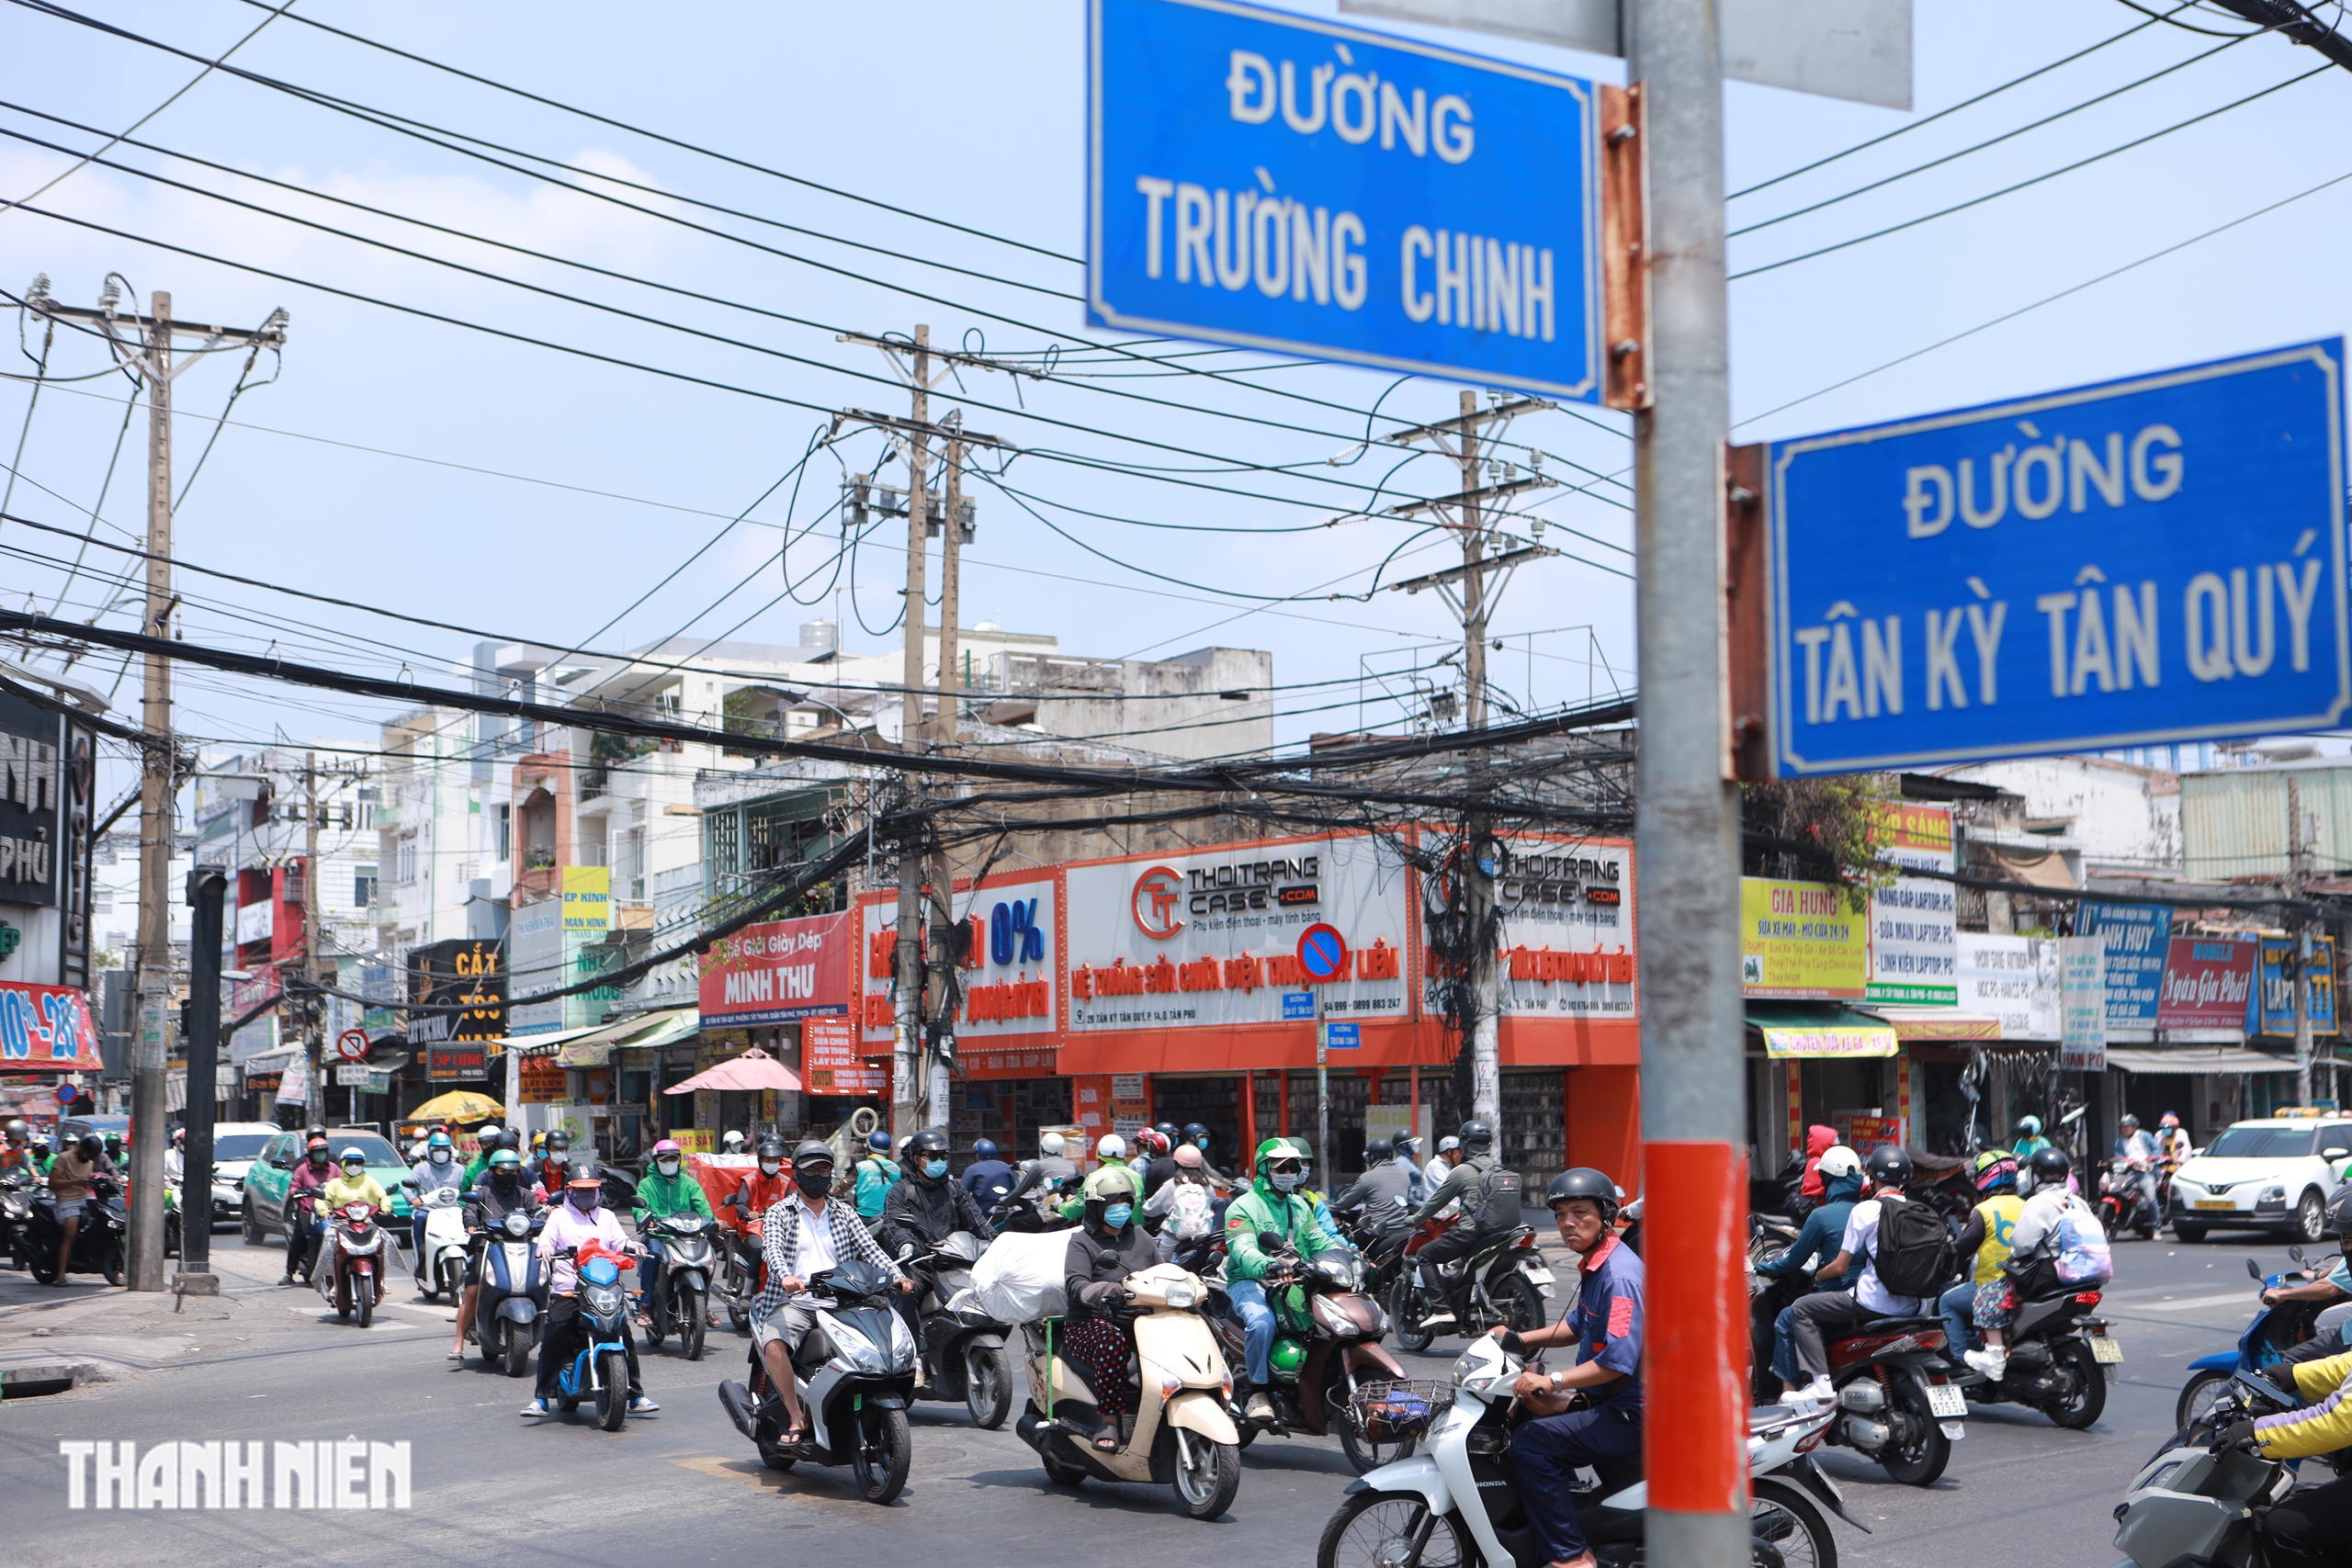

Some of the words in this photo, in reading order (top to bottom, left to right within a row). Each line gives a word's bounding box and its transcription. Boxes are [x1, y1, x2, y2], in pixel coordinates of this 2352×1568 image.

[1227, 42, 1476, 164] ĐƯỜNG
[1136, 166, 1368, 311] TRƯỜNG
[1401, 224, 1555, 343] CHINH
[1902, 420, 2185, 539] ĐƯỜNG
[1795, 600, 1904, 725] TÂN
[1927, 576, 2007, 710] KỲ
[2036, 564, 2160, 698] TÂN
[2185, 529, 2323, 683] QUÝ
[1906, 811, 1950, 847] SÁNG
[1187, 856, 1319, 889] THOITRANG
[563, 890, 578, 903] ÉP
[581, 891, 607, 903] KÍNH
[1189, 888, 1270, 915] CASE
[1501, 882, 1577, 904] CASE
[1772, 887, 1795, 914] GIA
[1800, 890, 1838, 917] HƯNG
[769, 932, 796, 955] Giày
[797, 930, 822, 953] Dép
[991, 897, 1045, 965] 0%
[1773, 920, 1781, 935] XE
[1895, 922, 1915, 941] MAIN
[2095, 923, 2125, 952] ANH
[2124, 924, 2155, 953] HUY
[456, 942, 499, 976] CẮT
[577, 950, 607, 973] NHÀ
[2191, 942, 2234, 963] MOBILE
[724, 967, 773, 1005] MINH
[776, 963, 816, 1000] THƯ
